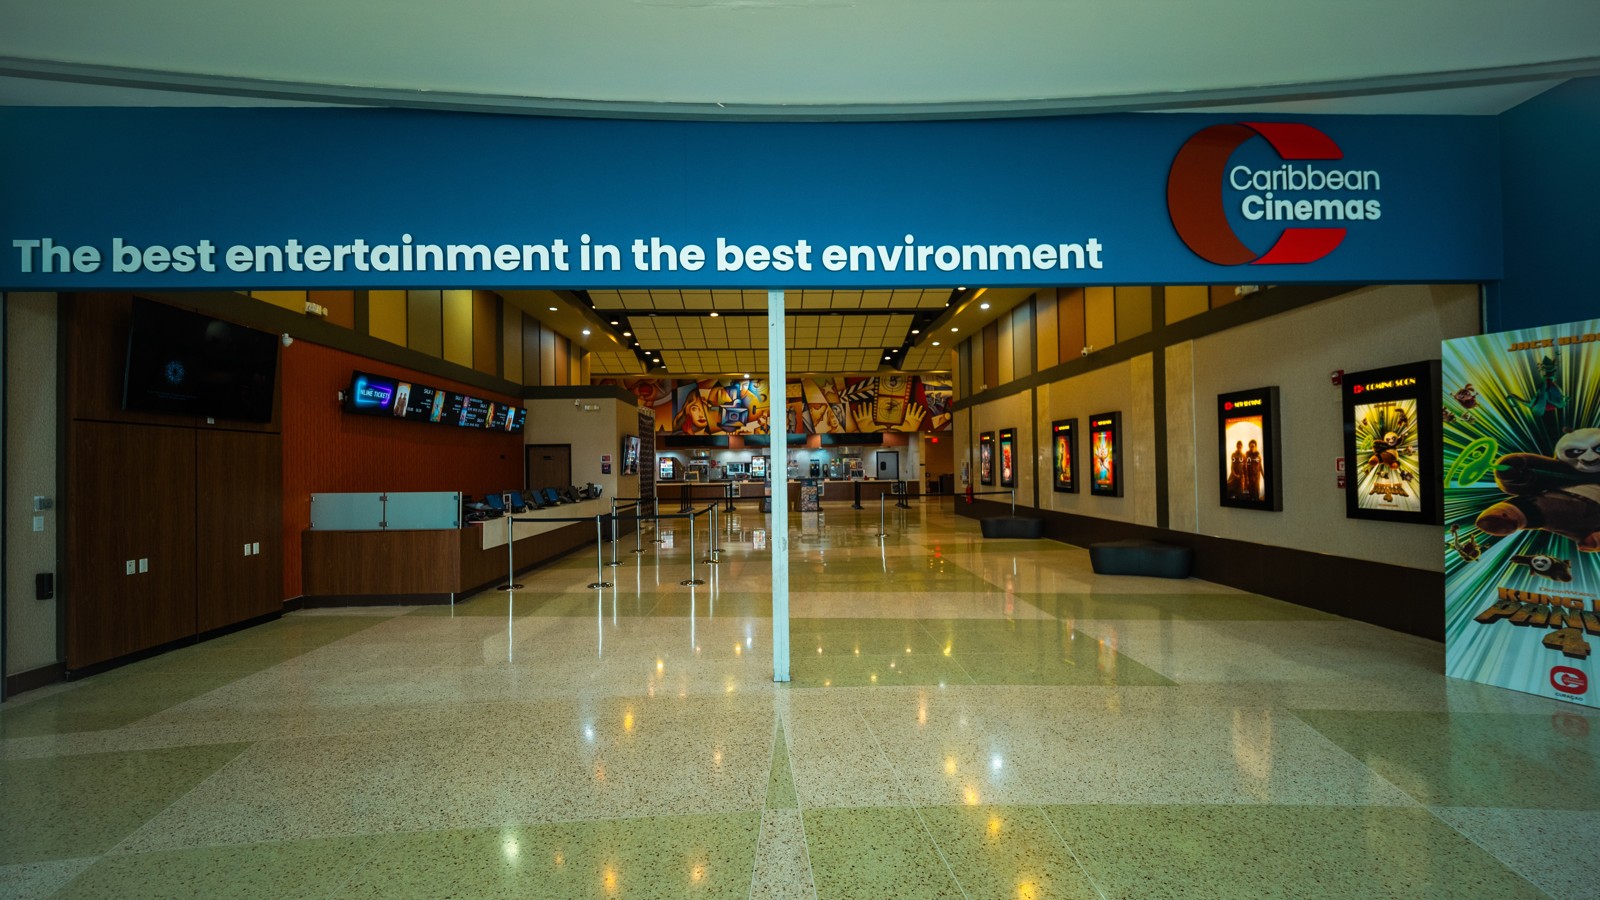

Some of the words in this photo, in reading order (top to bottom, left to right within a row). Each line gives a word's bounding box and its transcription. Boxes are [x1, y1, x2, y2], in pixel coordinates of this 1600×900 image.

[1230, 164, 1381, 191] Caribbean
[1241, 191, 1382, 221] Cinemas
[12, 238, 100, 273] The
[113, 237, 215, 273] best
[225, 233, 570, 272] entertainment
[580, 233, 621, 271] in
[631, 236, 706, 271] the
[717, 236, 813, 272] best
[822, 233, 1103, 272] environment
[1507, 339, 1553, 352] JACK
[1558, 333, 1600, 346] BLA
[1365, 381, 1394, 391] COMING
[1395, 378, 1416, 387] SOON
[1498, 587, 1584, 609] KUNG
[1542, 627, 1591, 660] 4
